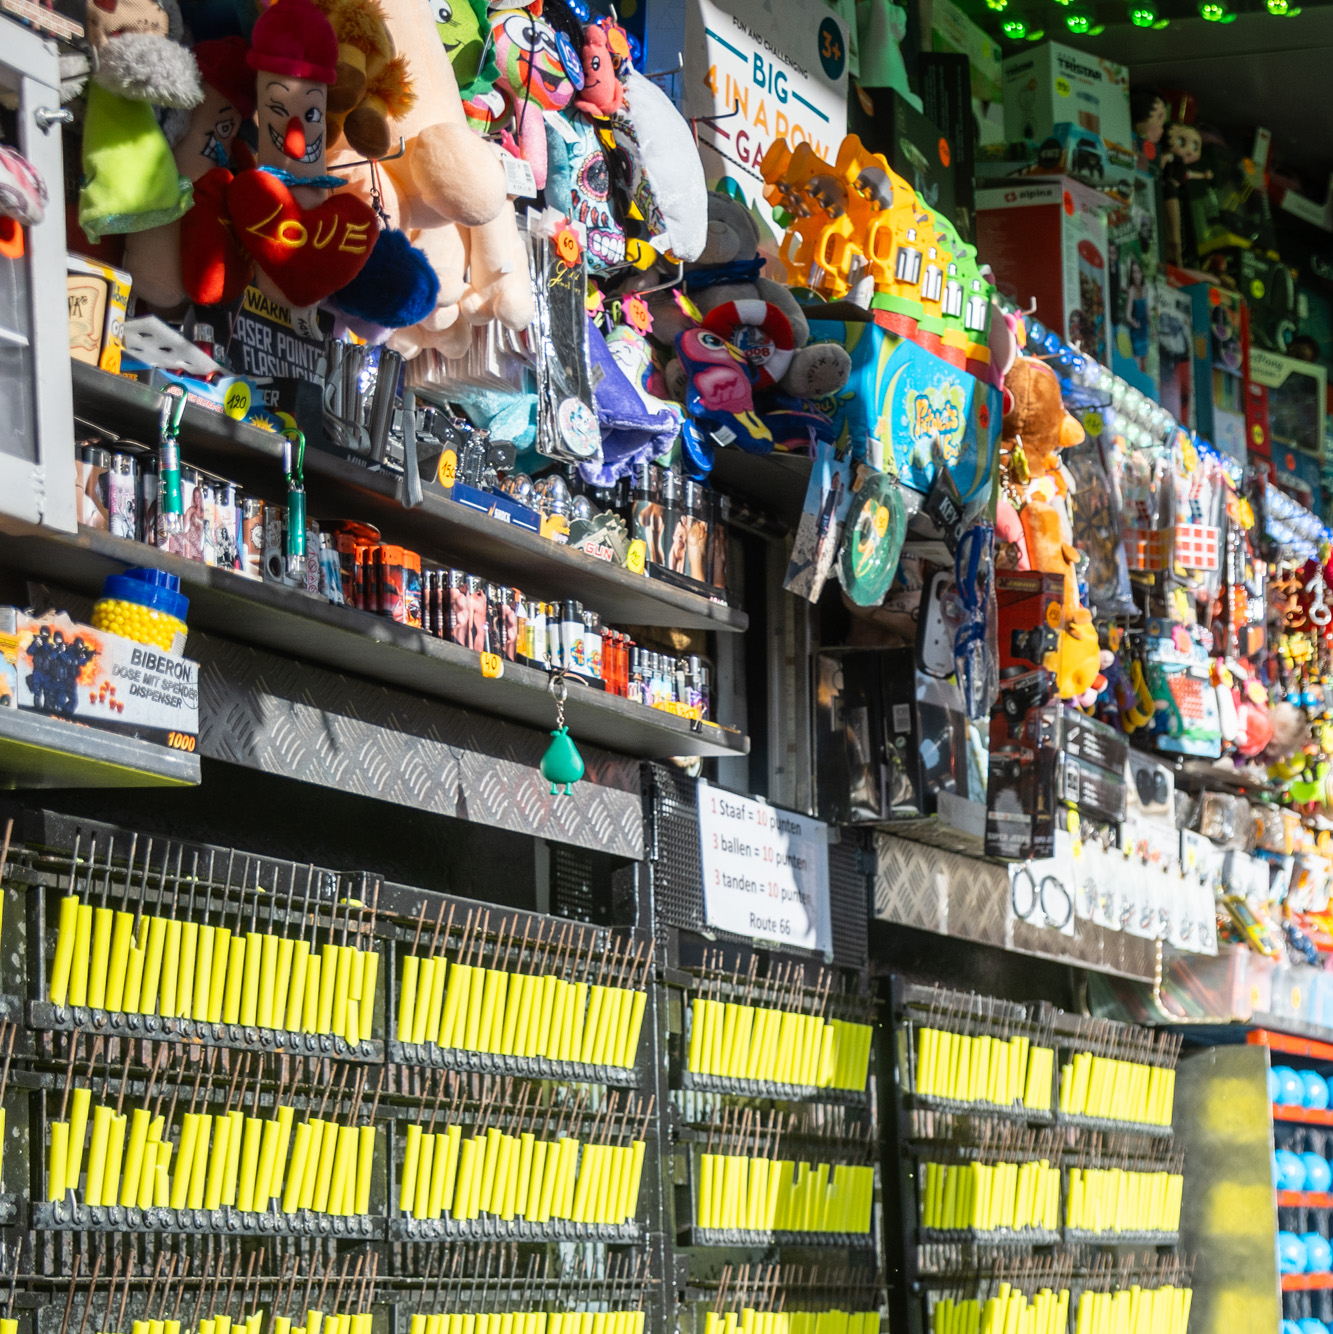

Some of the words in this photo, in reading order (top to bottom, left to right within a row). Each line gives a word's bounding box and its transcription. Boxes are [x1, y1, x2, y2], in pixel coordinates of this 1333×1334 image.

[732, 16, 747, 32] FUN
[748, 25, 762, 45] AND
[764, 40, 808, 79] CHALLENGING
[822, 30, 841, 61] 3+
[753, 52, 788, 104] BIG
[704, 64, 718, 98] 4
[725, 73, 748, 120] IN
[753, 99, 769, 136] A
[736, 130, 764, 168] GA
[246, 204, 371, 254] LOVE
[247, 289, 292, 323] WARN
[229, 312, 272, 353] LASER
[278, 332, 325, 370] POINT
[939, 496, 959, 525] KEY
[585, 542, 613, 561] GUN
[131, 648, 192, 682] BIBERON
[485, 656, 498, 671] 40
[112, 664, 141, 683] DOSE
[142, 671, 159, 688] MIT
[161, 679, 198, 702] SPENDER
[129, 684, 182, 709] DISPENSER
[167, 731, 196, 752] 1000
[711, 797, 717, 814] 1
[720, 800, 745, 820] Staaf
[757, 810, 767, 827] 10
[770, 817, 802, 836] punten
[713, 833, 718, 849] 3
[721, 834, 751, 857] ballen
[763, 846, 774, 862] 10
[776, 852, 807, 872] punten
[714, 869, 720, 885] 3
[723, 872, 757, 893] tanden
[768, 882, 779, 898] 10
[750, 912, 777, 933] Route
[780, 919, 791, 935] 66
